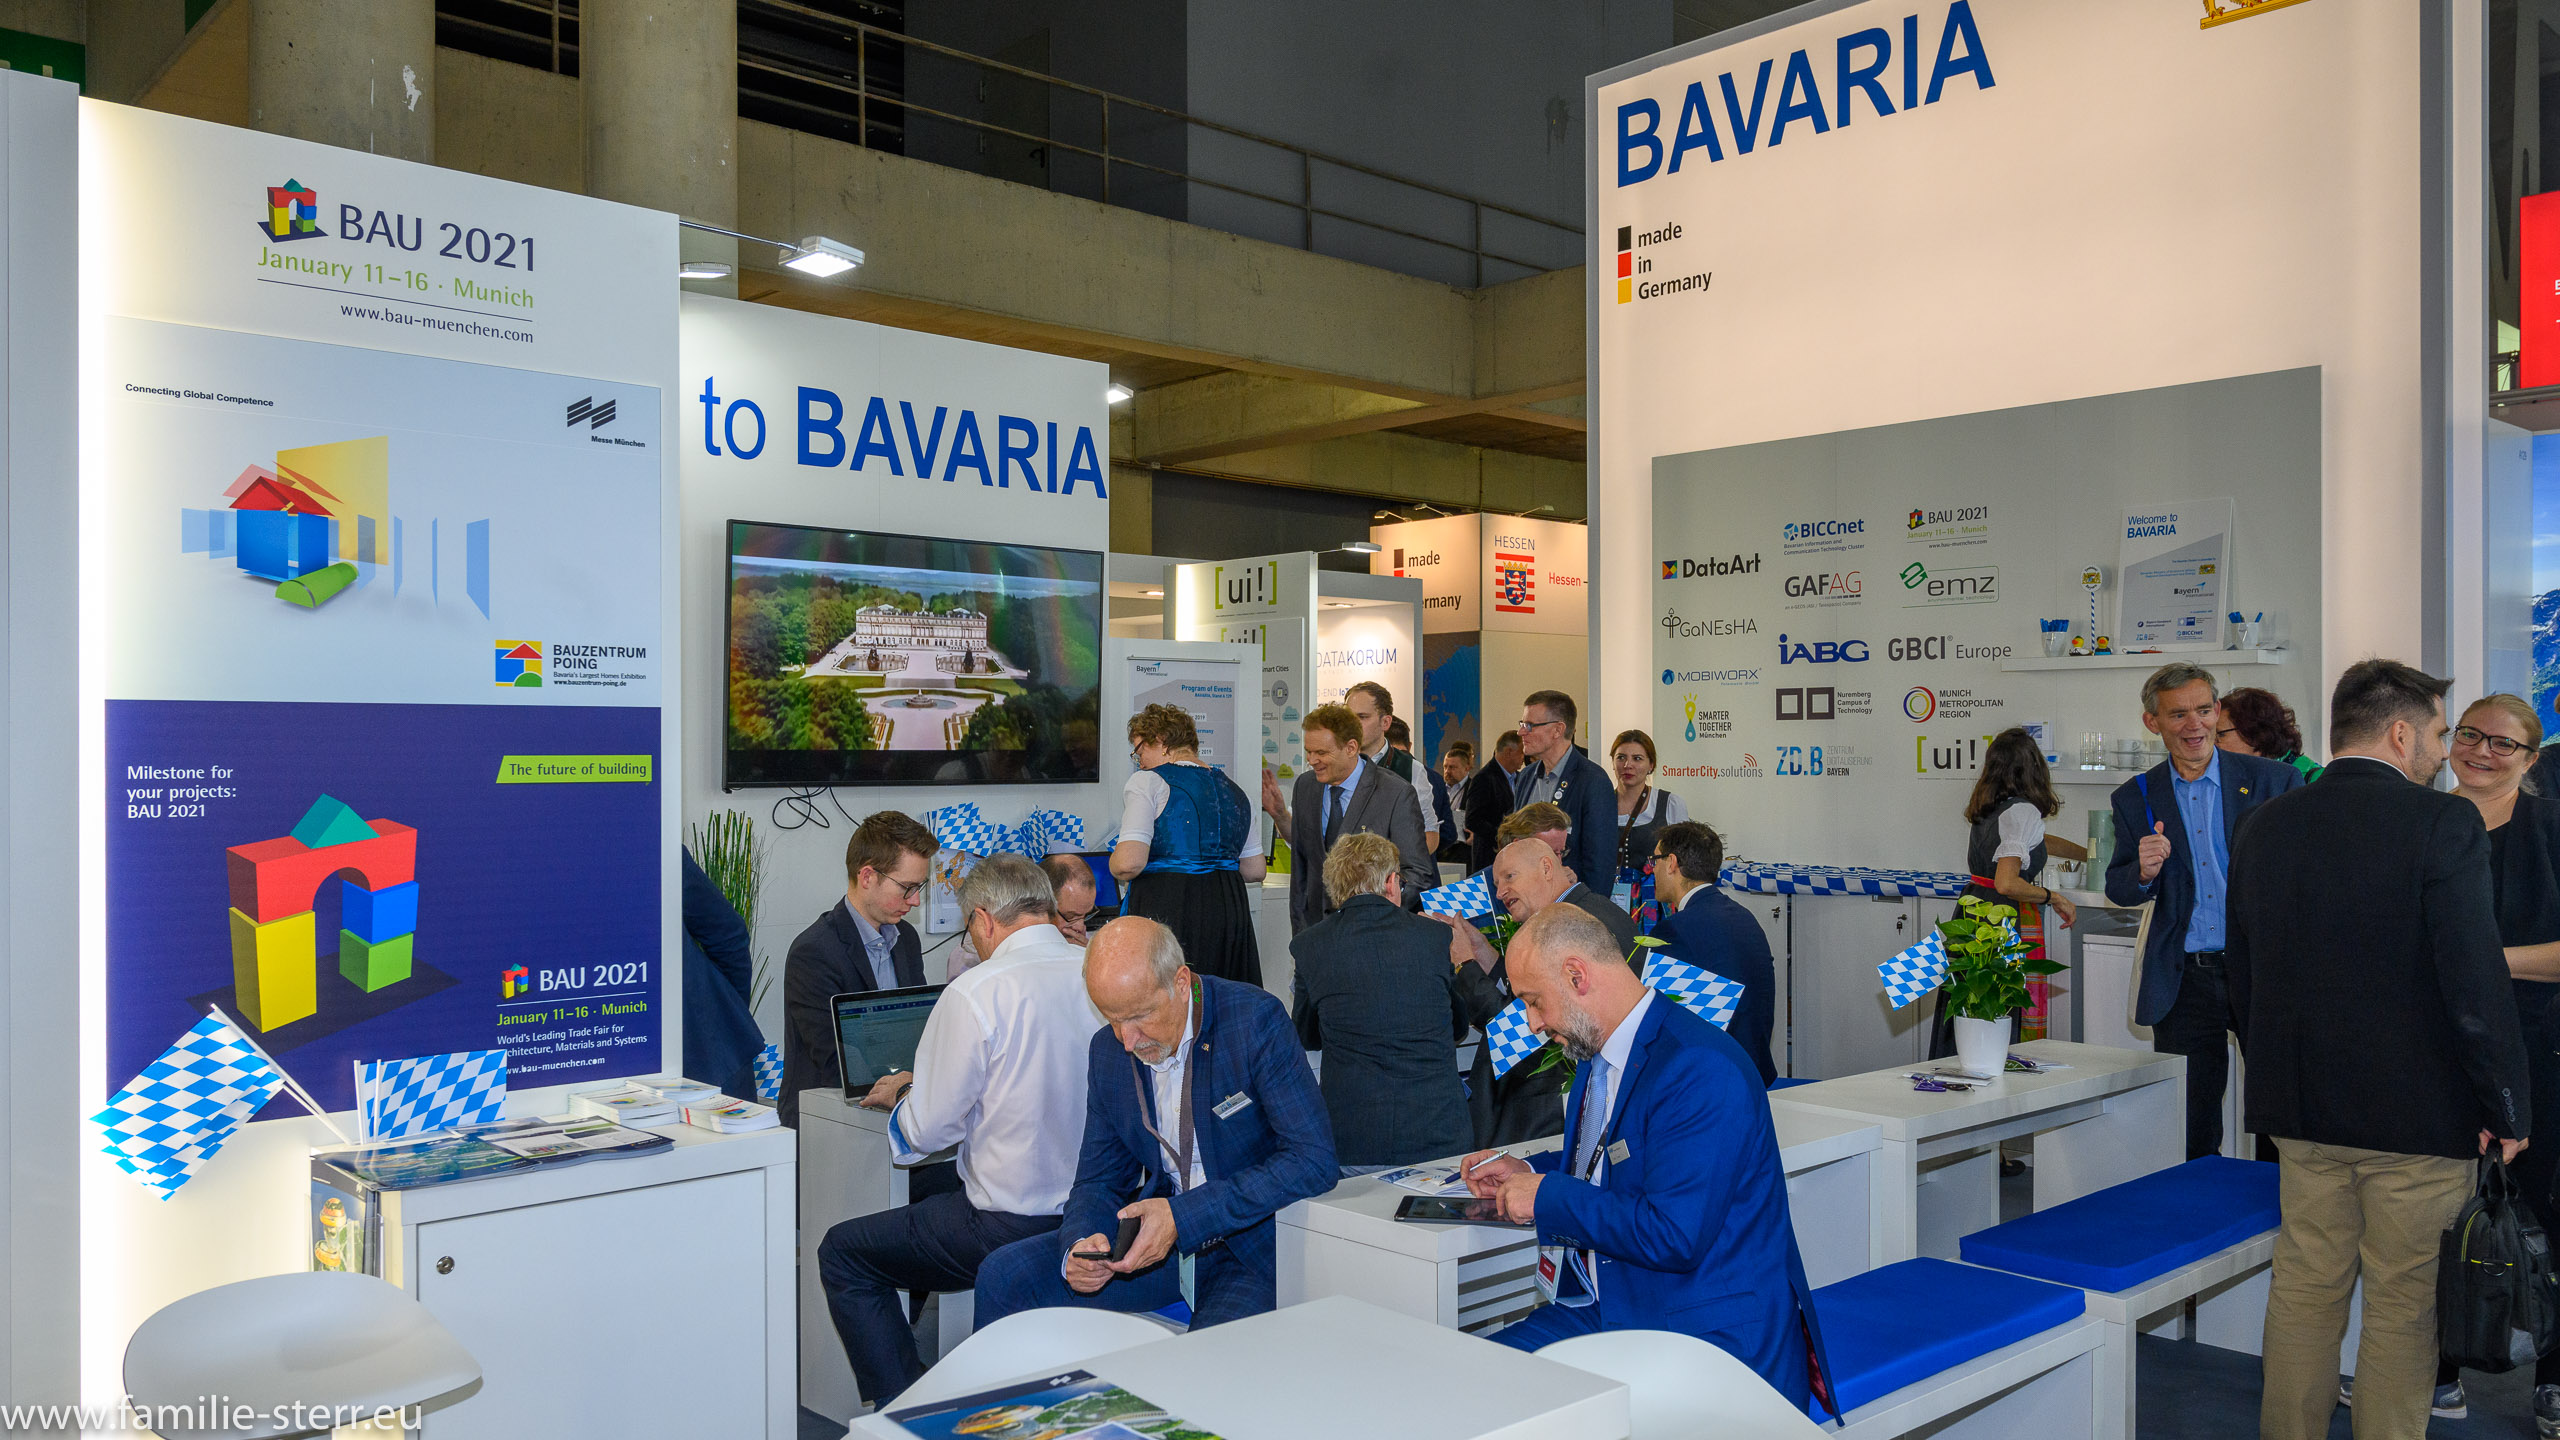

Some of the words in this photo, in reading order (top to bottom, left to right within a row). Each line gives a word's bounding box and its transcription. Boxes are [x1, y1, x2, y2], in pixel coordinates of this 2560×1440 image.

[1616, 0, 1997, 189] BAVARIA
[340, 203, 422, 251] BAU
[439, 222, 534, 272] 2021
[1637, 221, 1683, 249] made
[1637, 253, 1652, 275] in
[257, 246, 353, 285] January
[454, 277, 534, 309] Munich
[1637, 270, 1712, 301] Germany
[340, 305, 533, 343] www.bau-muenchen.com
[125, 383, 181, 398] Connecting
[183, 389, 214, 401] Global
[216, 393, 274, 407] Competence
[591, 435, 613, 445] Messe
[614, 438, 646, 448] München
[699, 375, 766, 461] to
[797, 385, 1108, 500] BAVARIA
[1928, 510, 1953, 524] BAU
[1957, 506, 1987, 521] 2021
[2127, 515, 2167, 526] Welcome
[2169, 513, 2178, 522] to
[1801, 519, 1864, 538] BICCnet
[1907, 530, 1933, 539] January
[1961, 525, 1987, 534] Munich
[2127, 524, 2176, 539] BAVARIA
[1494, 535, 1535, 551] HESSEN
[1408, 550, 1440, 568] made
[1683, 553, 1761, 578] DataArt
[1549, 571, 1581, 587] Hessen
[1927, 576, 1995, 597] emz
[2174, 588, 2199, 598] Bayern
[553, 644, 646, 658] BAUZENTRUM
[1317, 648, 1397, 667] DATAKORUM
[1956, 644, 2012, 661] Europe
[553, 658, 598, 670] POING
[1136, 665, 1157, 673] Bayern
[553, 671, 578, 680] Bavaria's
[579, 672, 599, 681] Largest
[1677, 669, 1758, 682] MOBIWORX
[553, 680, 627, 688] www.bauzentrum-poing.de
[1181, 684, 1206, 693] Program
[1214, 685, 1232, 693] Events
[1837, 691, 1872, 699] Nuremberg
[1939, 690, 1971, 698] MUNICH
[1837, 699, 1863, 707] Campus
[1939, 699, 2004, 708] METROPOLITAN
[1698, 711, 1729, 721] SMARTER
[1838, 707, 1873, 715] Technology
[1939, 711, 1971, 719] REGION
[1699, 722, 1732, 732] TOGETHER
[127, 765, 205, 780] Milestone
[211, 765, 234, 779] for
[509, 763, 532, 775] The
[537, 763, 576, 776] future
[581, 763, 595, 775] of
[599, 763, 647, 778] building
[1662, 764, 1763, 779] SmarterCity.solutions
[1827, 768, 1850, 776] BAYERN
[126, 788, 164, 803] your
[169, 784, 236, 802] projects:
[127, 804, 162, 819] BAU
[168, 804, 205, 818] 2021
[539, 966, 586, 992] BAU
[593, 961, 648, 987] 2021
[496, 1011, 548, 1026] January
[602, 1000, 647, 1016] Munich
[532, 1029, 566, 1042] Leading
[568, 1027, 592, 1039] Trade
[593, 1025, 610, 1035] Fair
[611, 1024, 625, 1034] for
[507, 1044, 553, 1058] chitecture,
[555, 1038, 595, 1052] Materials
[596, 1037, 612, 1048] and
[614, 1034, 648, 1047] Systems
[506, 1057, 605, 1075] ww.bau-muenchen.com
